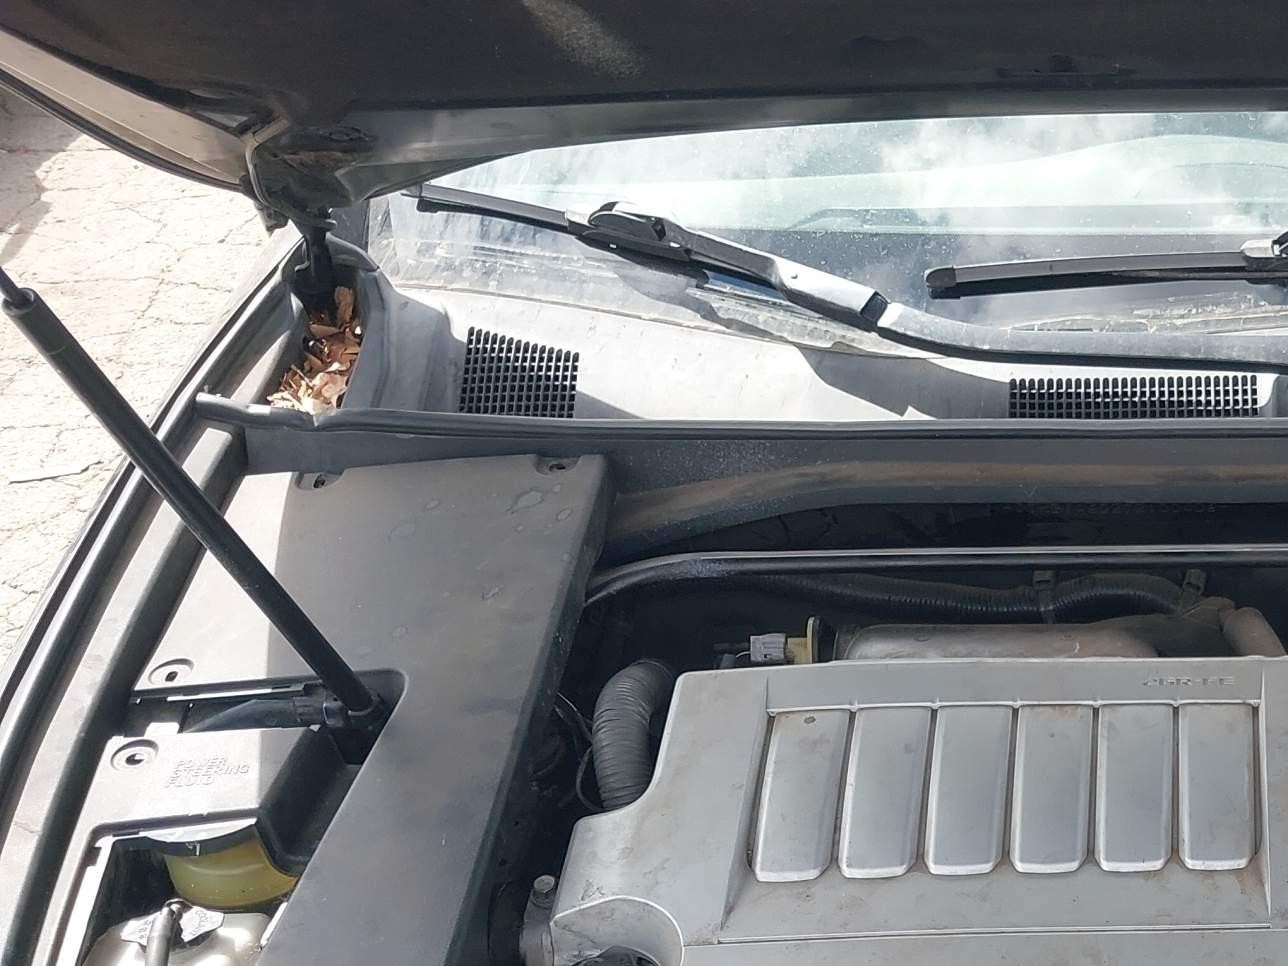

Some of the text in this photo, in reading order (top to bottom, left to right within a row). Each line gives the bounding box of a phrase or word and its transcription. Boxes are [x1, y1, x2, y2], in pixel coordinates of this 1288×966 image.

[174, 756, 228, 769] POWER
[173, 764, 250, 778] STEERING
[164, 775, 216, 788] FLUID
